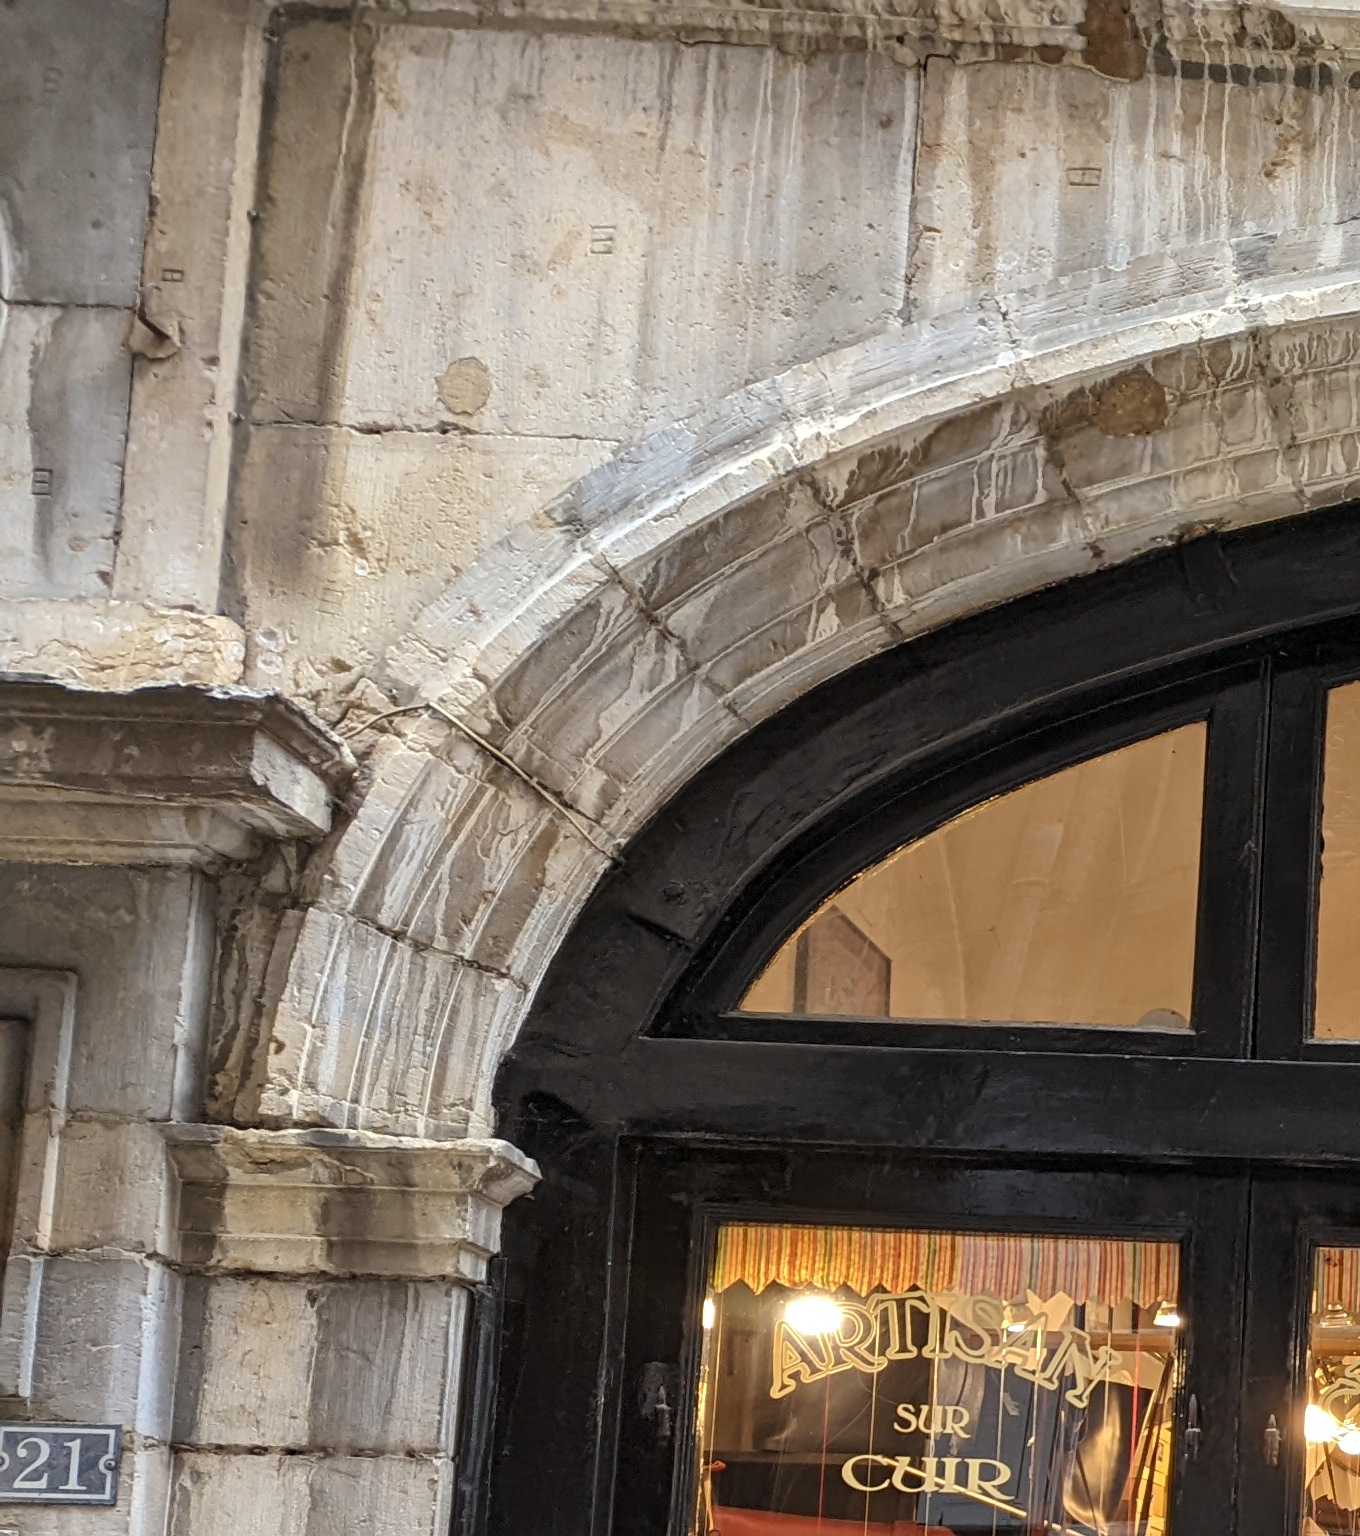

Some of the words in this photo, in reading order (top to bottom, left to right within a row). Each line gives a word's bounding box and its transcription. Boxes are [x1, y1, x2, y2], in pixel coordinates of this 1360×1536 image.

[769, 1290, 1122, 1408] ARTISAN
[893, 1403, 971, 1439] SUR
[13, 1437, 88, 1490] 21
[841, 1455, 1016, 1500] CUIR
